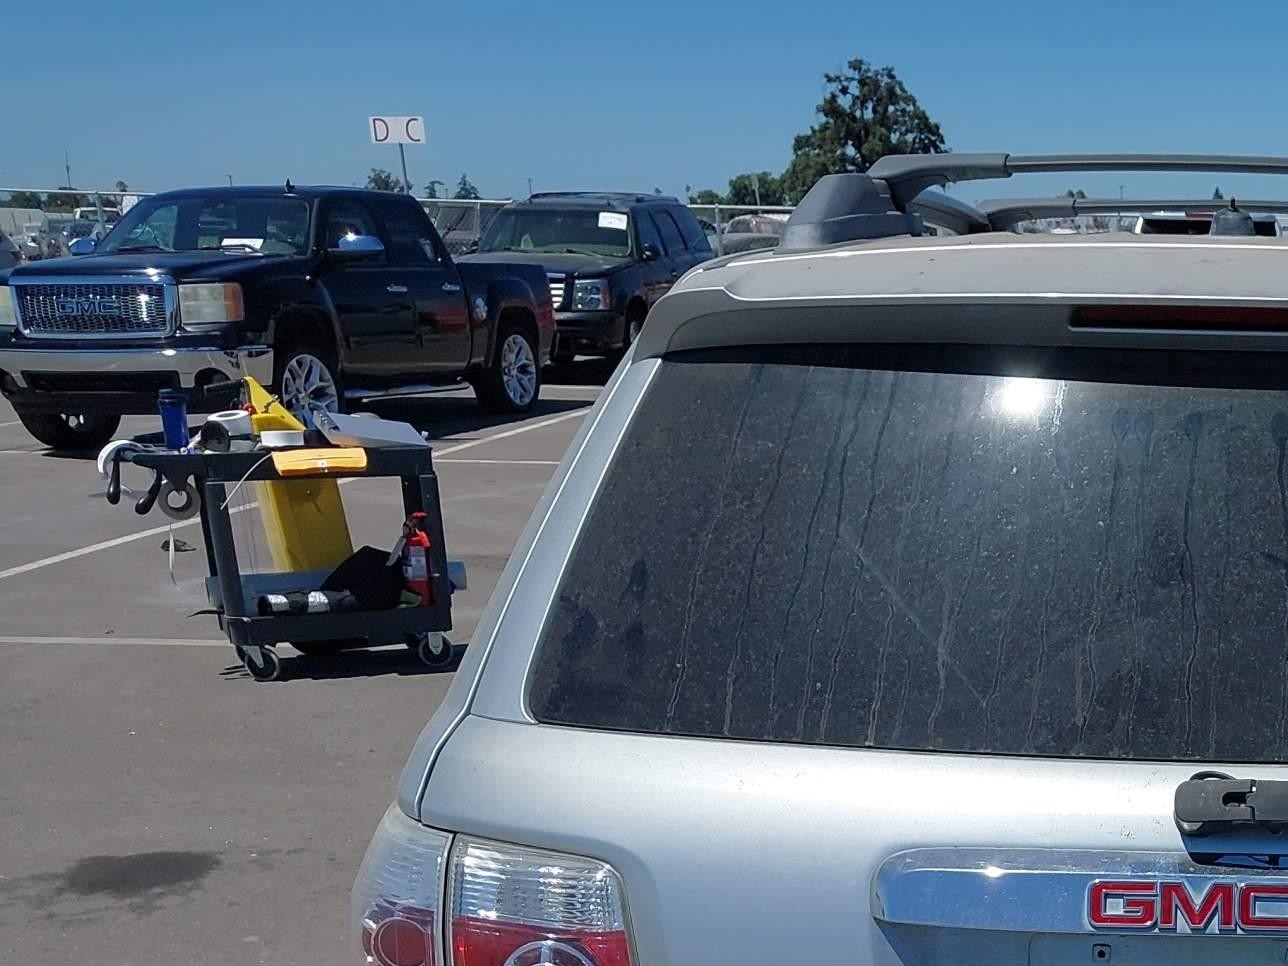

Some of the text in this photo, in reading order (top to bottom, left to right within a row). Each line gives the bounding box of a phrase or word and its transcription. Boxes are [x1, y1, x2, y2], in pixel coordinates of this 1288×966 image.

[372, 118, 421, 142] D C
[55, 300, 119, 315] GMC
